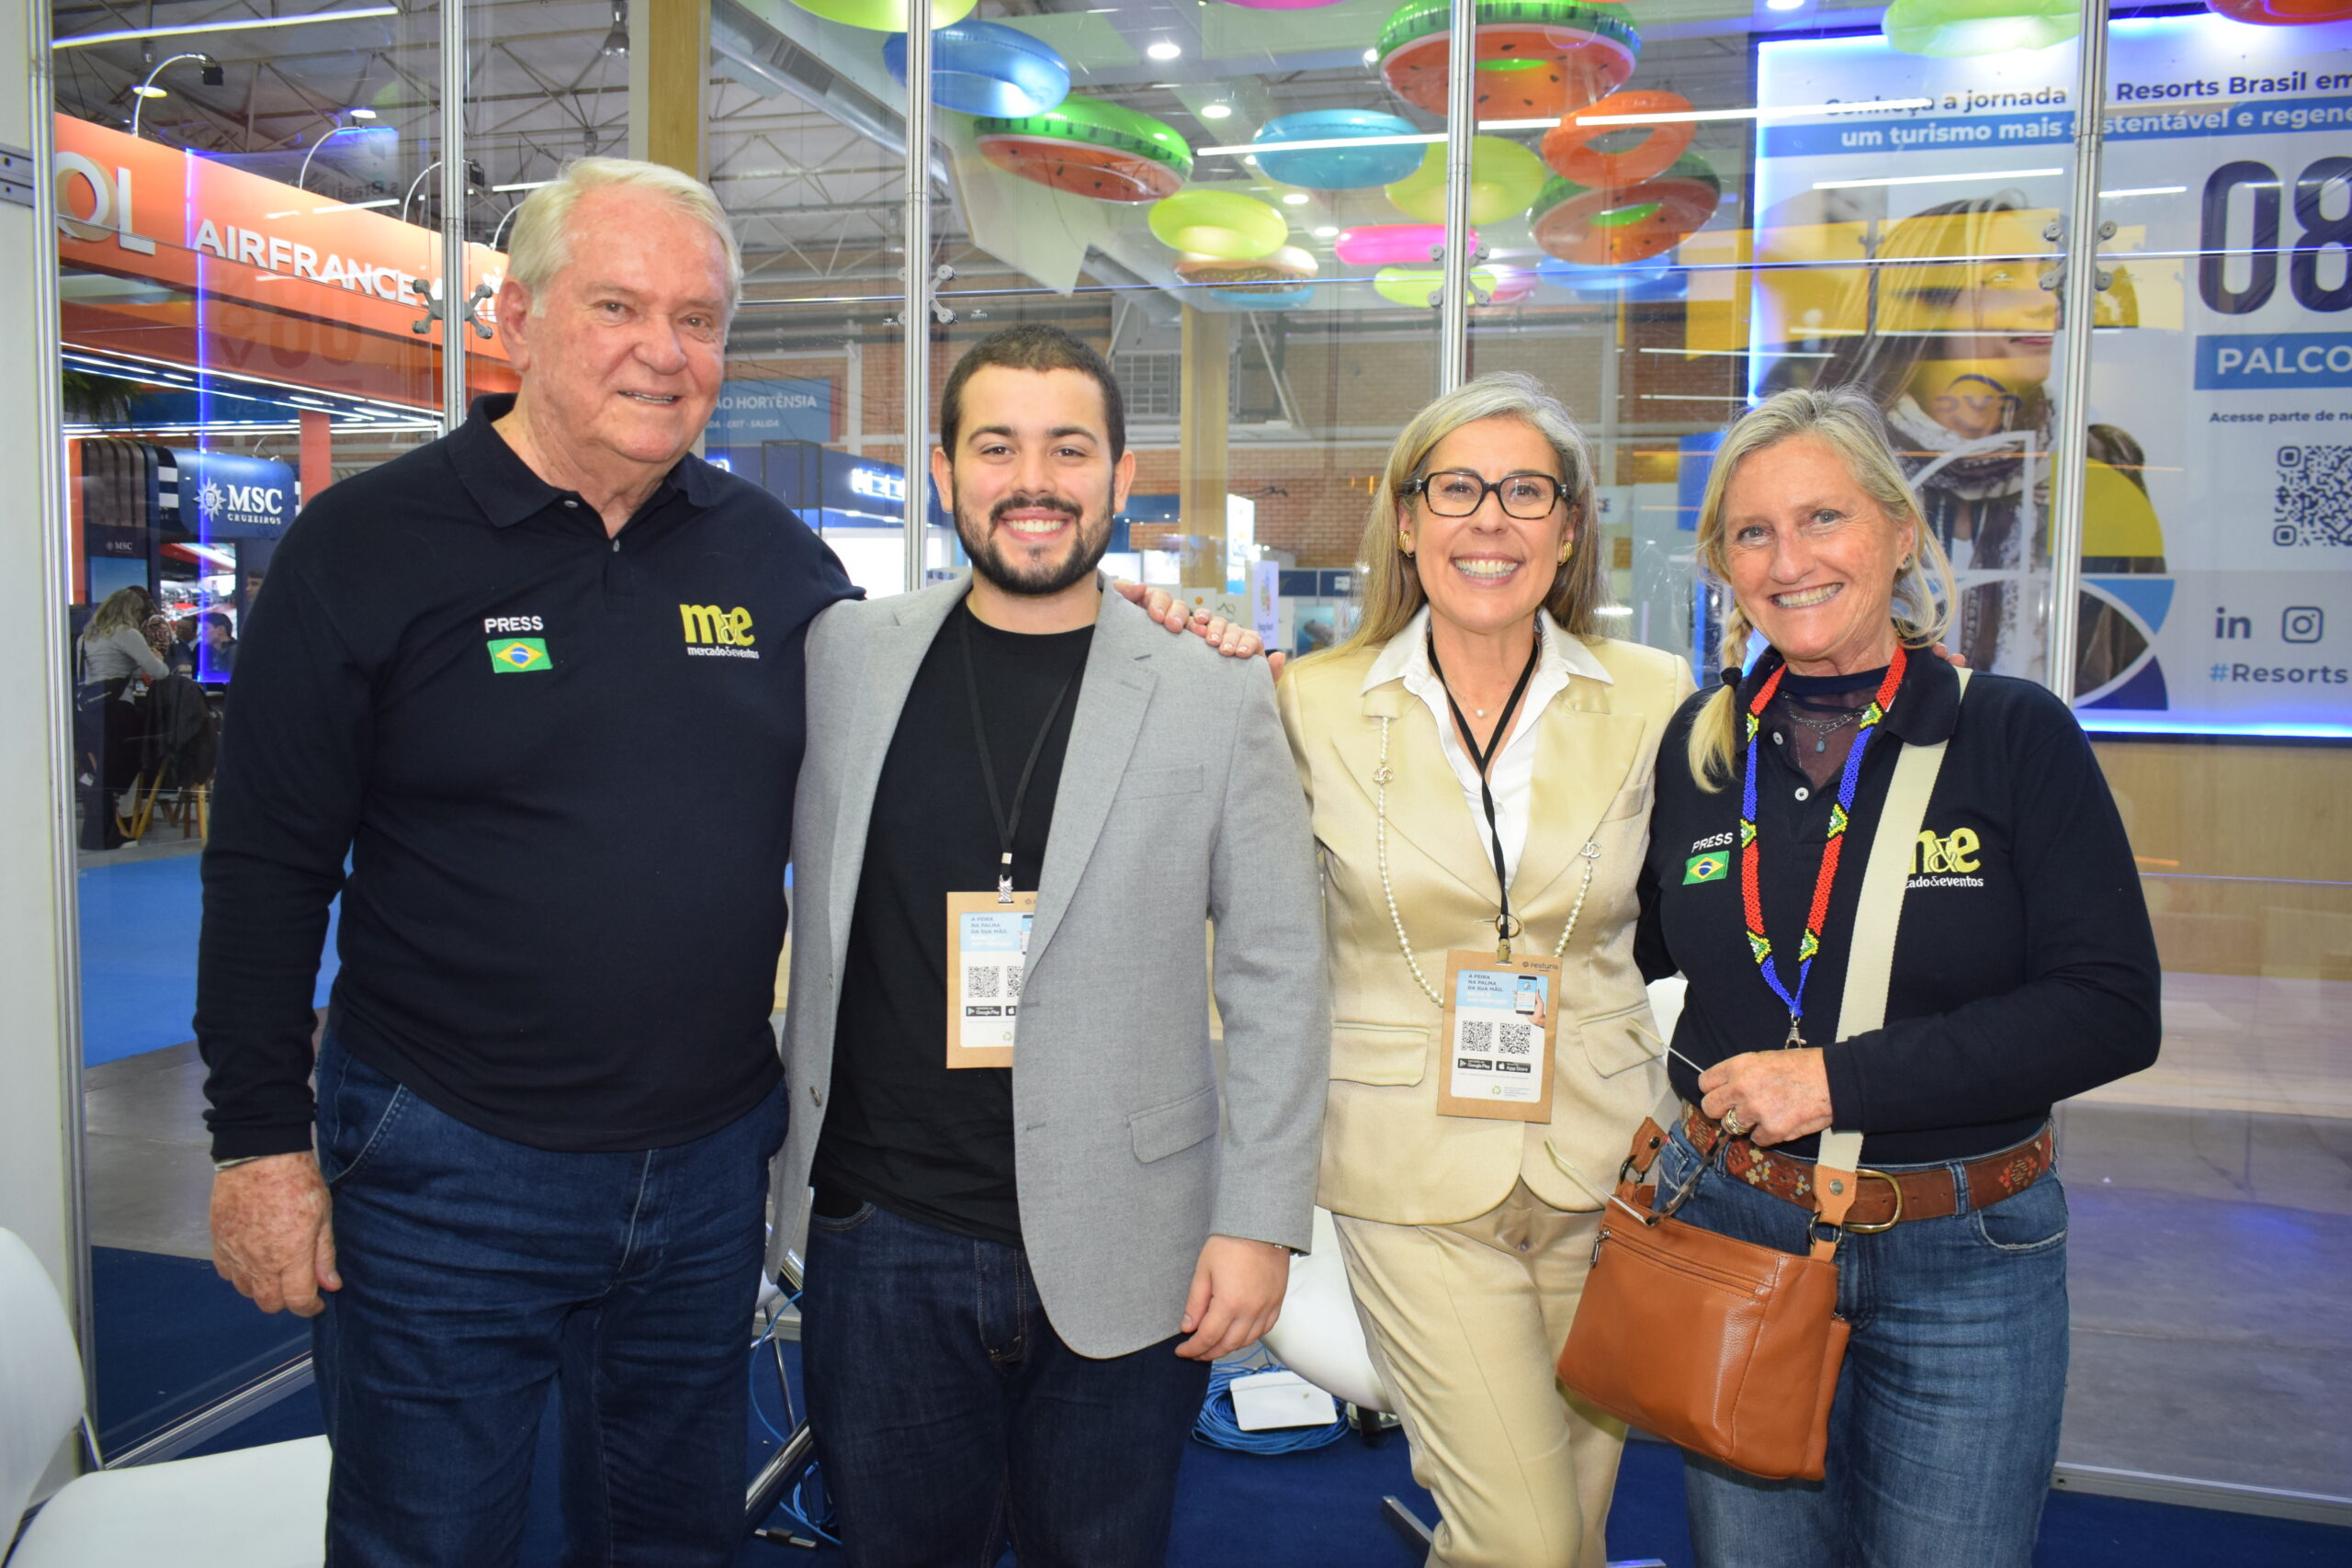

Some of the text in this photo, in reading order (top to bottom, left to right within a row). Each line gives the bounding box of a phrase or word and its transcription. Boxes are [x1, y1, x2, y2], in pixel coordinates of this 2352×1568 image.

[2116, 71, 2352, 101] Resorts Brasil em
[1944, 95, 1957, 110] a
[1962, 86, 2067, 113] jornada
[1841, 130, 1883, 147] um
[1889, 122, 1992, 145] turismo
[1998, 117, 2064, 140] mais
[2068, 108, 2230, 136] stentável
[2236, 111, 2254, 128] e
[2198, 155, 2352, 315] 08
[193, 219, 418, 307] AIRFRANCE
[2216, 345, 2352, 375] PALCO
[736, 392, 819, 409] HORTÊNSIA
[2209, 412, 2264, 423] Acesse
[2268, 412, 2311, 424] parte
[2315, 410, 2335, 422] de
[226, 484, 283, 514] MSC
[227, 513, 282, 525] CRUZEIROS
[114, 542, 133, 551] MSC
[484, 615, 544, 634] PRESS
[2210, 663, 2349, 683] #Resorts
[1690, 831, 1734, 853] PRESS
